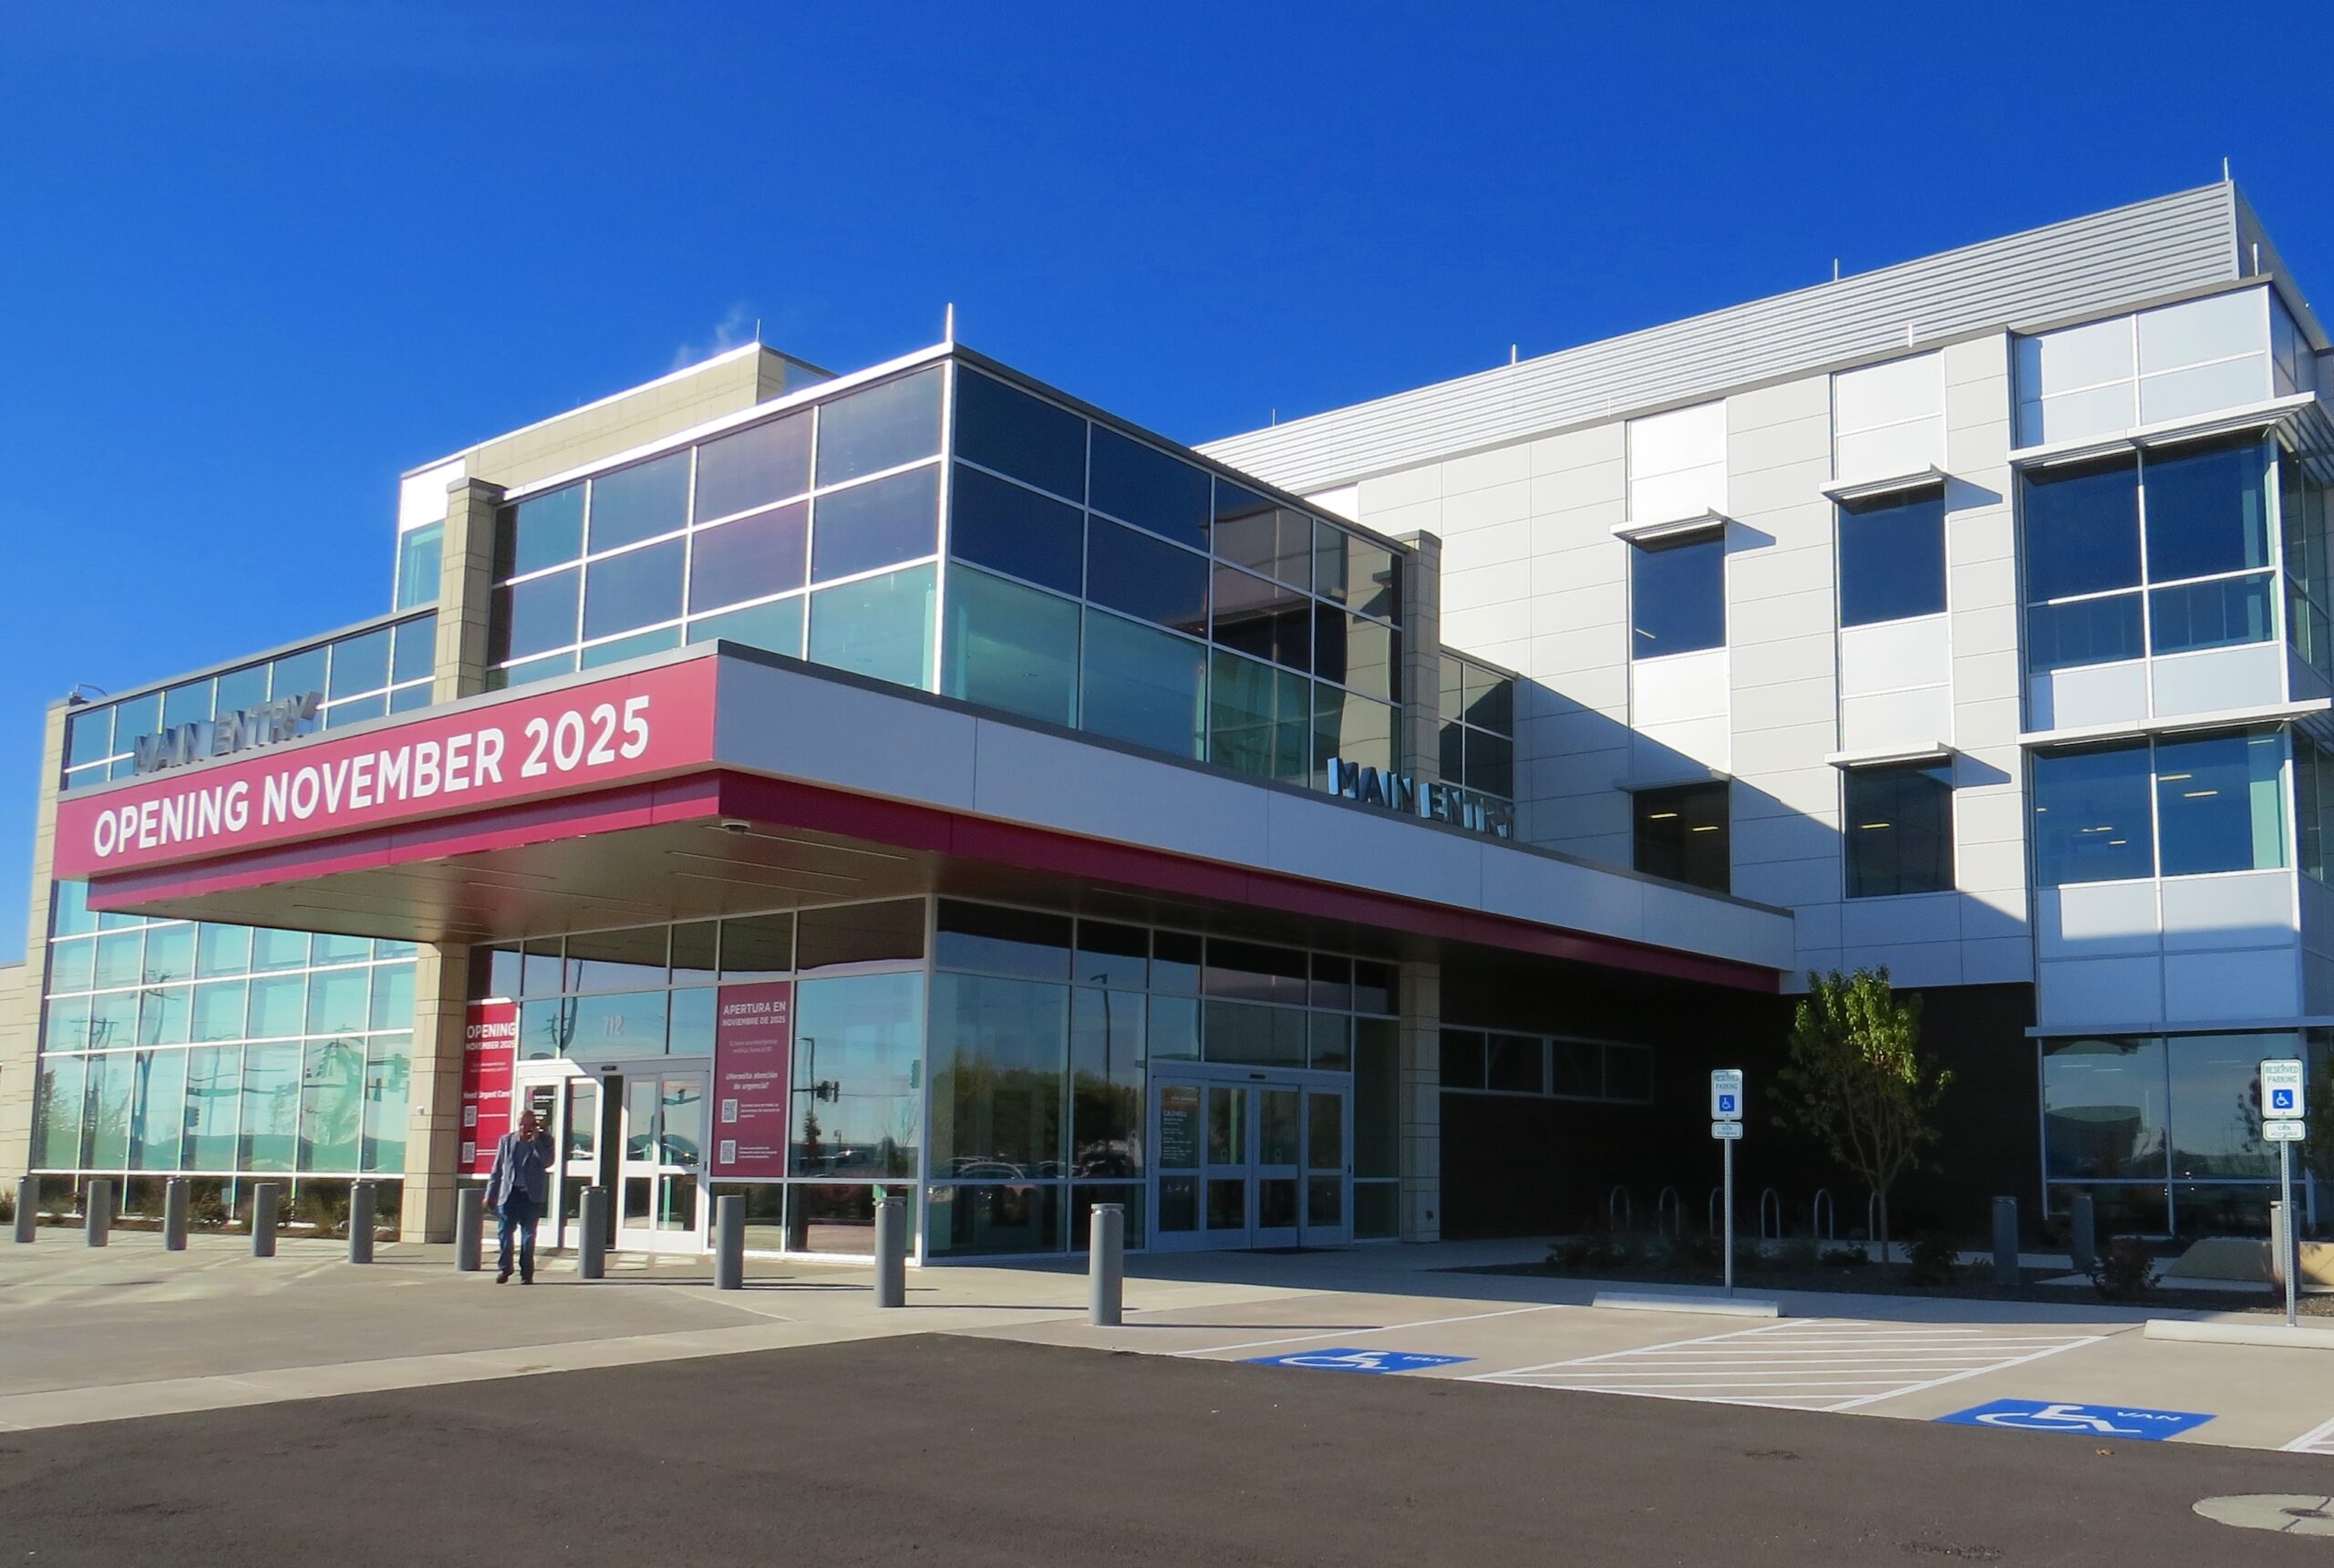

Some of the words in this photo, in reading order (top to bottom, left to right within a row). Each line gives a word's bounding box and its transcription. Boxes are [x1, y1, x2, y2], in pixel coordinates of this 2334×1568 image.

[134, 720, 214, 775] MAIN
[212, 691, 323, 757] ENTRY
[94, 781, 249, 857] OPENING
[262, 727, 505, 826] NOVEMBER
[521, 695, 650, 779] 2025
[1327, 756, 1412, 812] MAIN
[723, 1002, 771, 1016] APERTURA
[773, 1001, 787, 1013] EN
[722, 1016, 759, 1026] NOVIEMBRE
[760, 1016, 769, 1025] DE
[770, 1015, 786, 1024] 2025
[467, 1022, 516, 1038] OPENING
[466, 1041, 500, 1051] NOVEMBER
[2266, 1066, 2298, 1074] RESERVED
[2117, 1411, 2182, 1421] VAN
